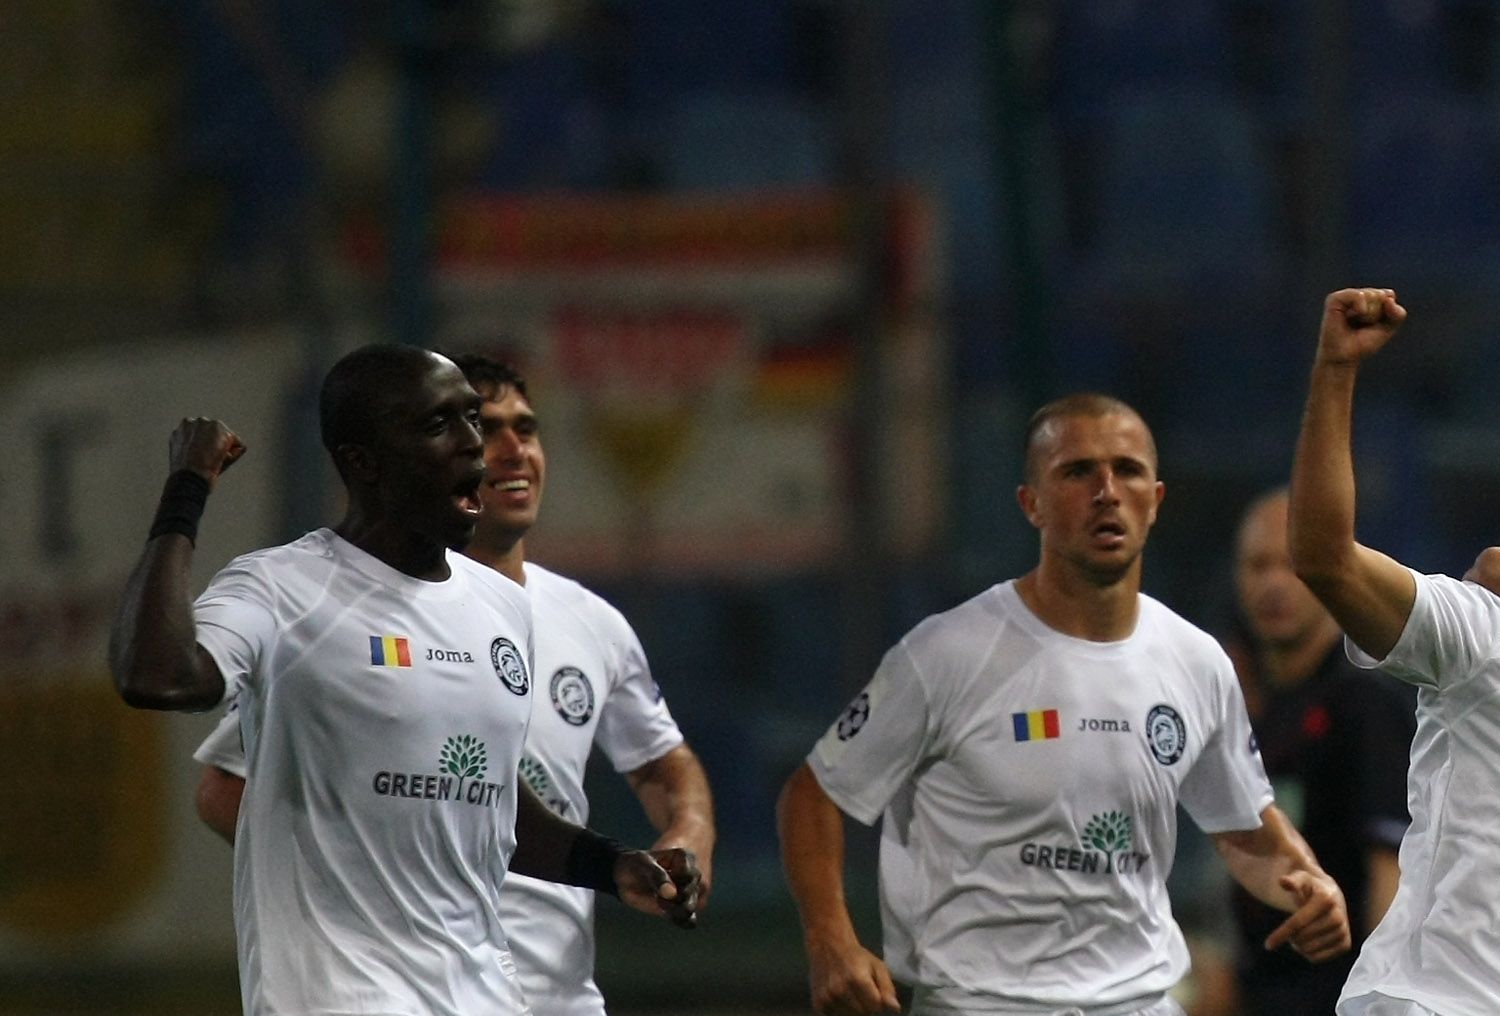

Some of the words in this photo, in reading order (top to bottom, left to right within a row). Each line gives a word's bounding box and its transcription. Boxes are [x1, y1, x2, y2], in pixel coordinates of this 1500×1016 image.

[426, 648, 475, 663] Joma
[1078, 718, 1132, 733] Joma
[372, 770, 453, 801] GREEN
[466, 780, 505, 809] CITY
[1020, 842, 1100, 874] GREEN
